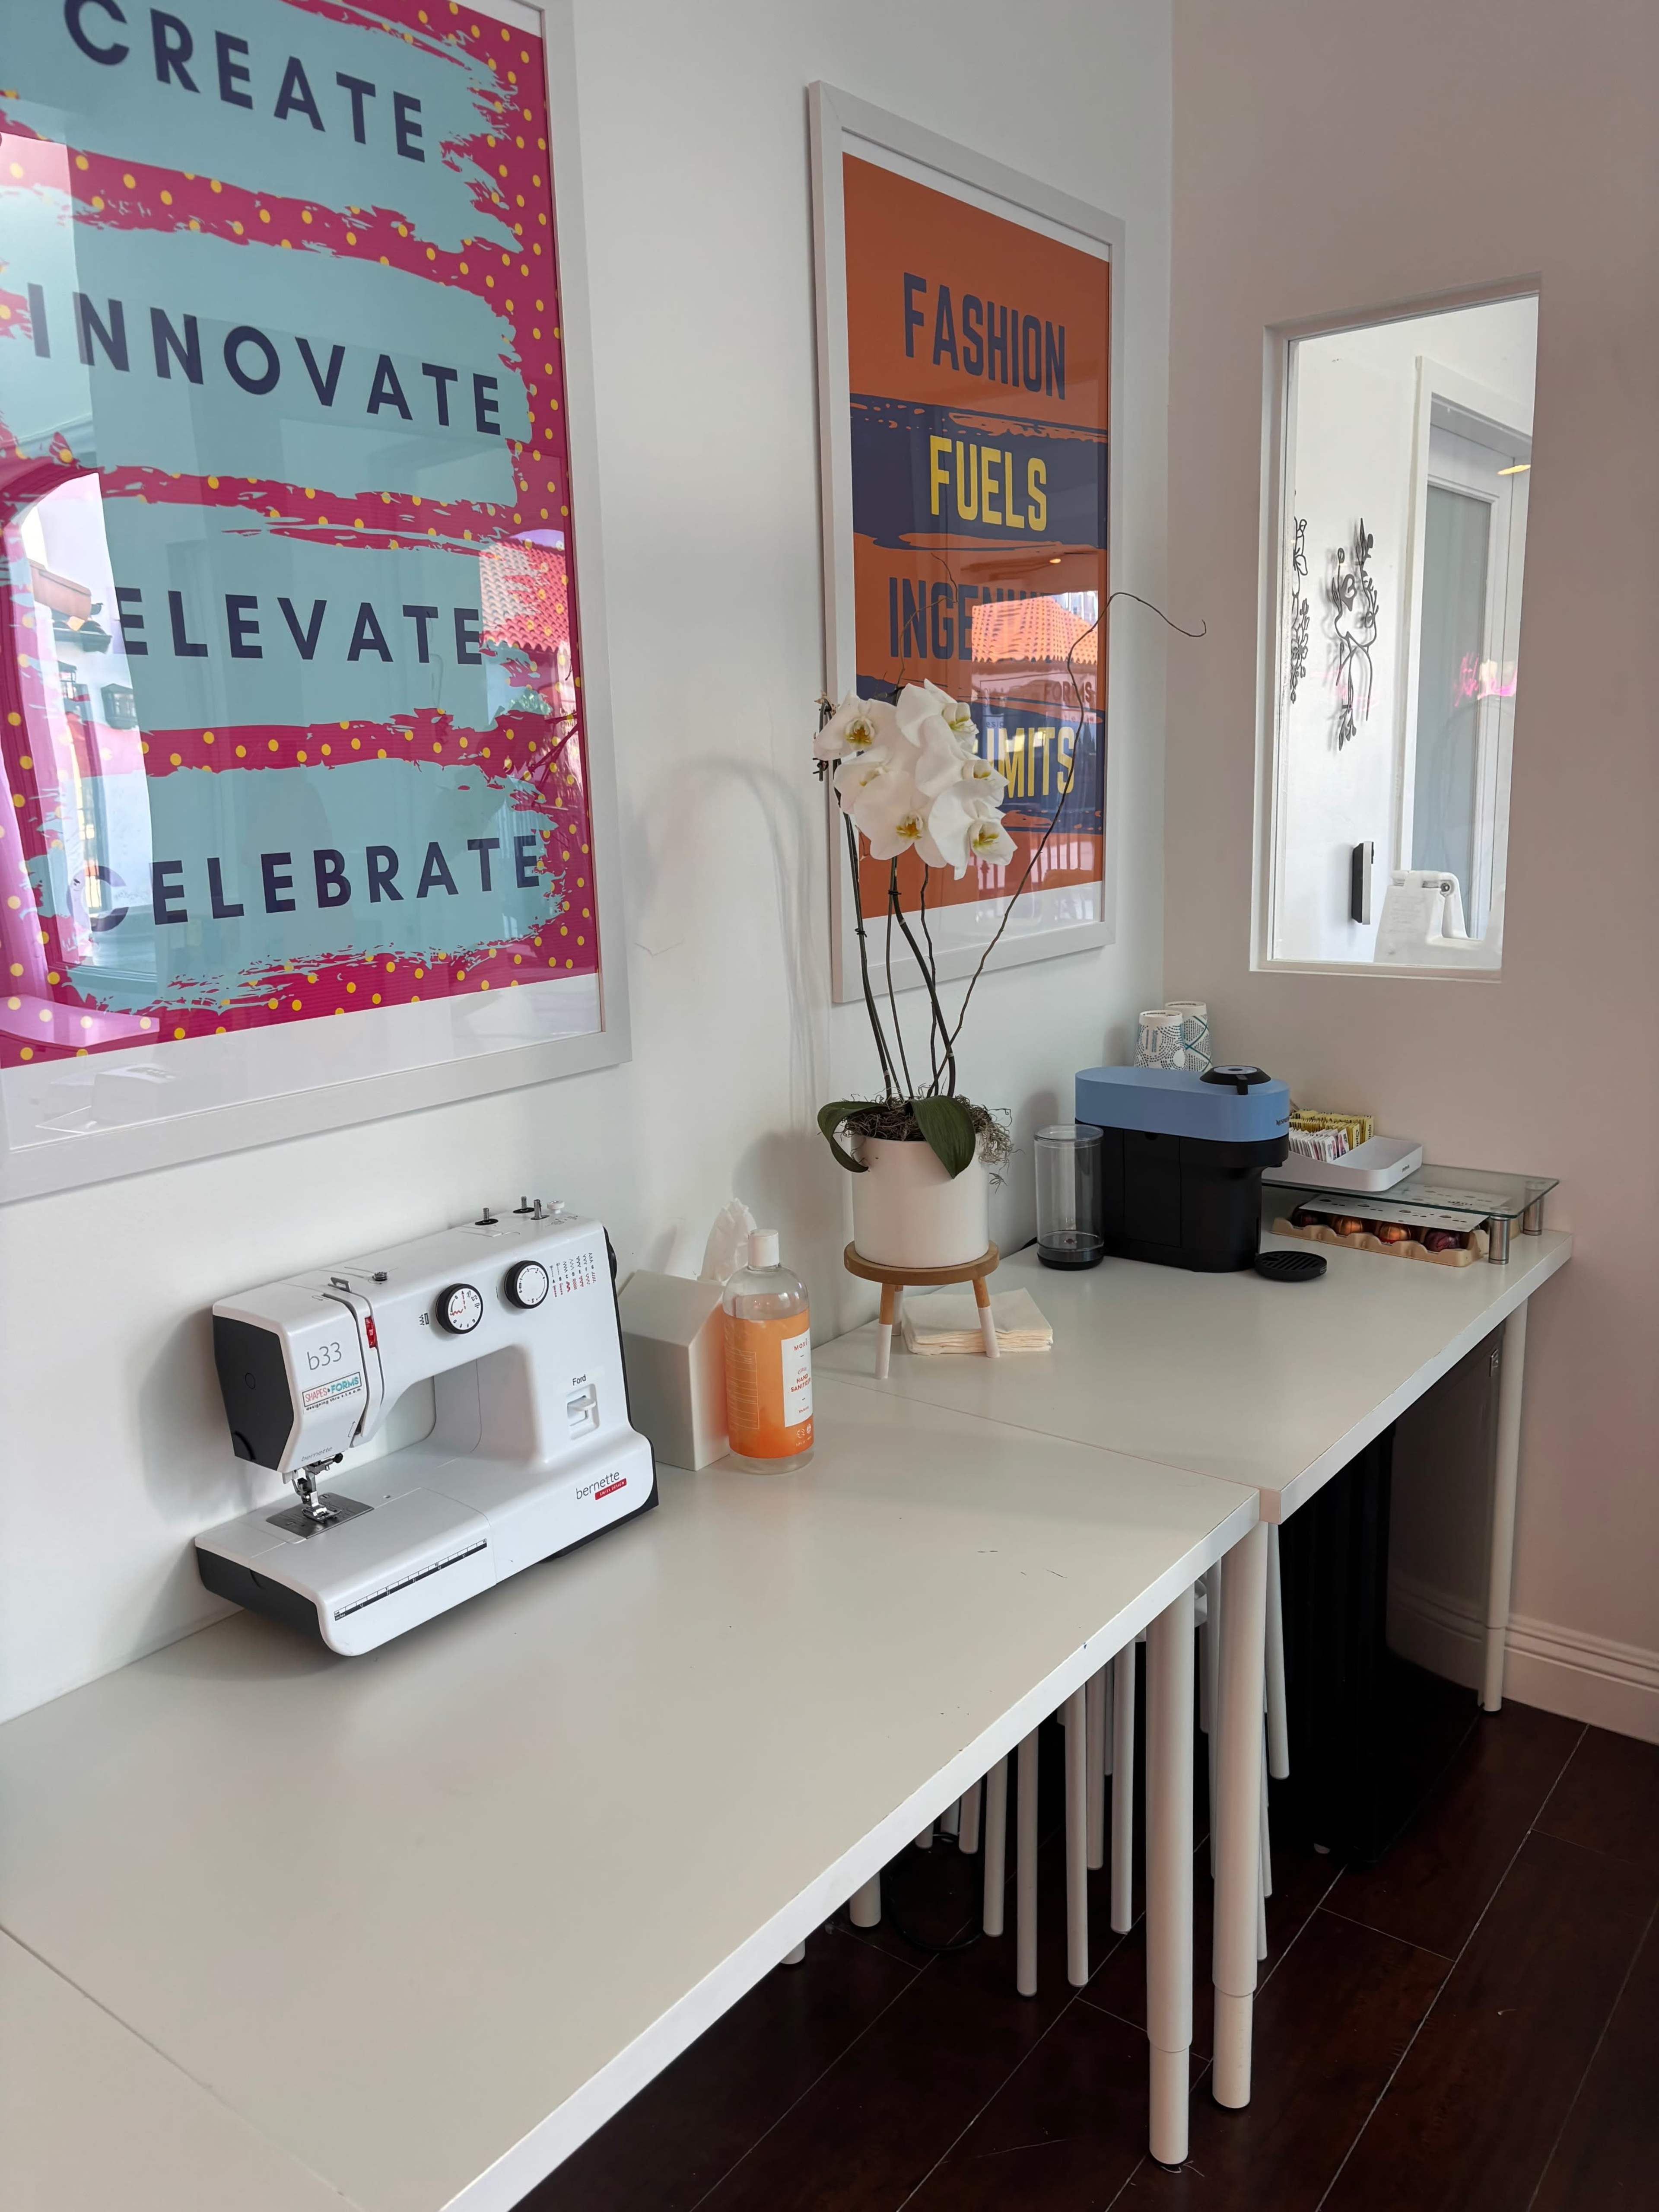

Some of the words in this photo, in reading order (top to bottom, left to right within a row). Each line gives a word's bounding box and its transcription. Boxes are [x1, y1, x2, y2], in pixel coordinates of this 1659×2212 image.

[64, 0, 425, 162] CREATE
[27, 282, 501, 436] INNOVATE
[903, 272, 1066, 400] FASHION
[929, 434, 1047, 532] FUELS
[114, 586, 483, 665] ELEVATE
[972, 727, 1075, 799] IMITS
[66, 835, 540, 933] CELEBRATE
[305, 1387, 327, 1402] SHAPES
[331, 1376, 359, 1394] FORMS
[307, 1342, 342, 1371] b33
[572, 1374, 587, 1386] Ford
[306, 1400, 329, 1410] designing
[575, 1471, 620, 1500] bernette
